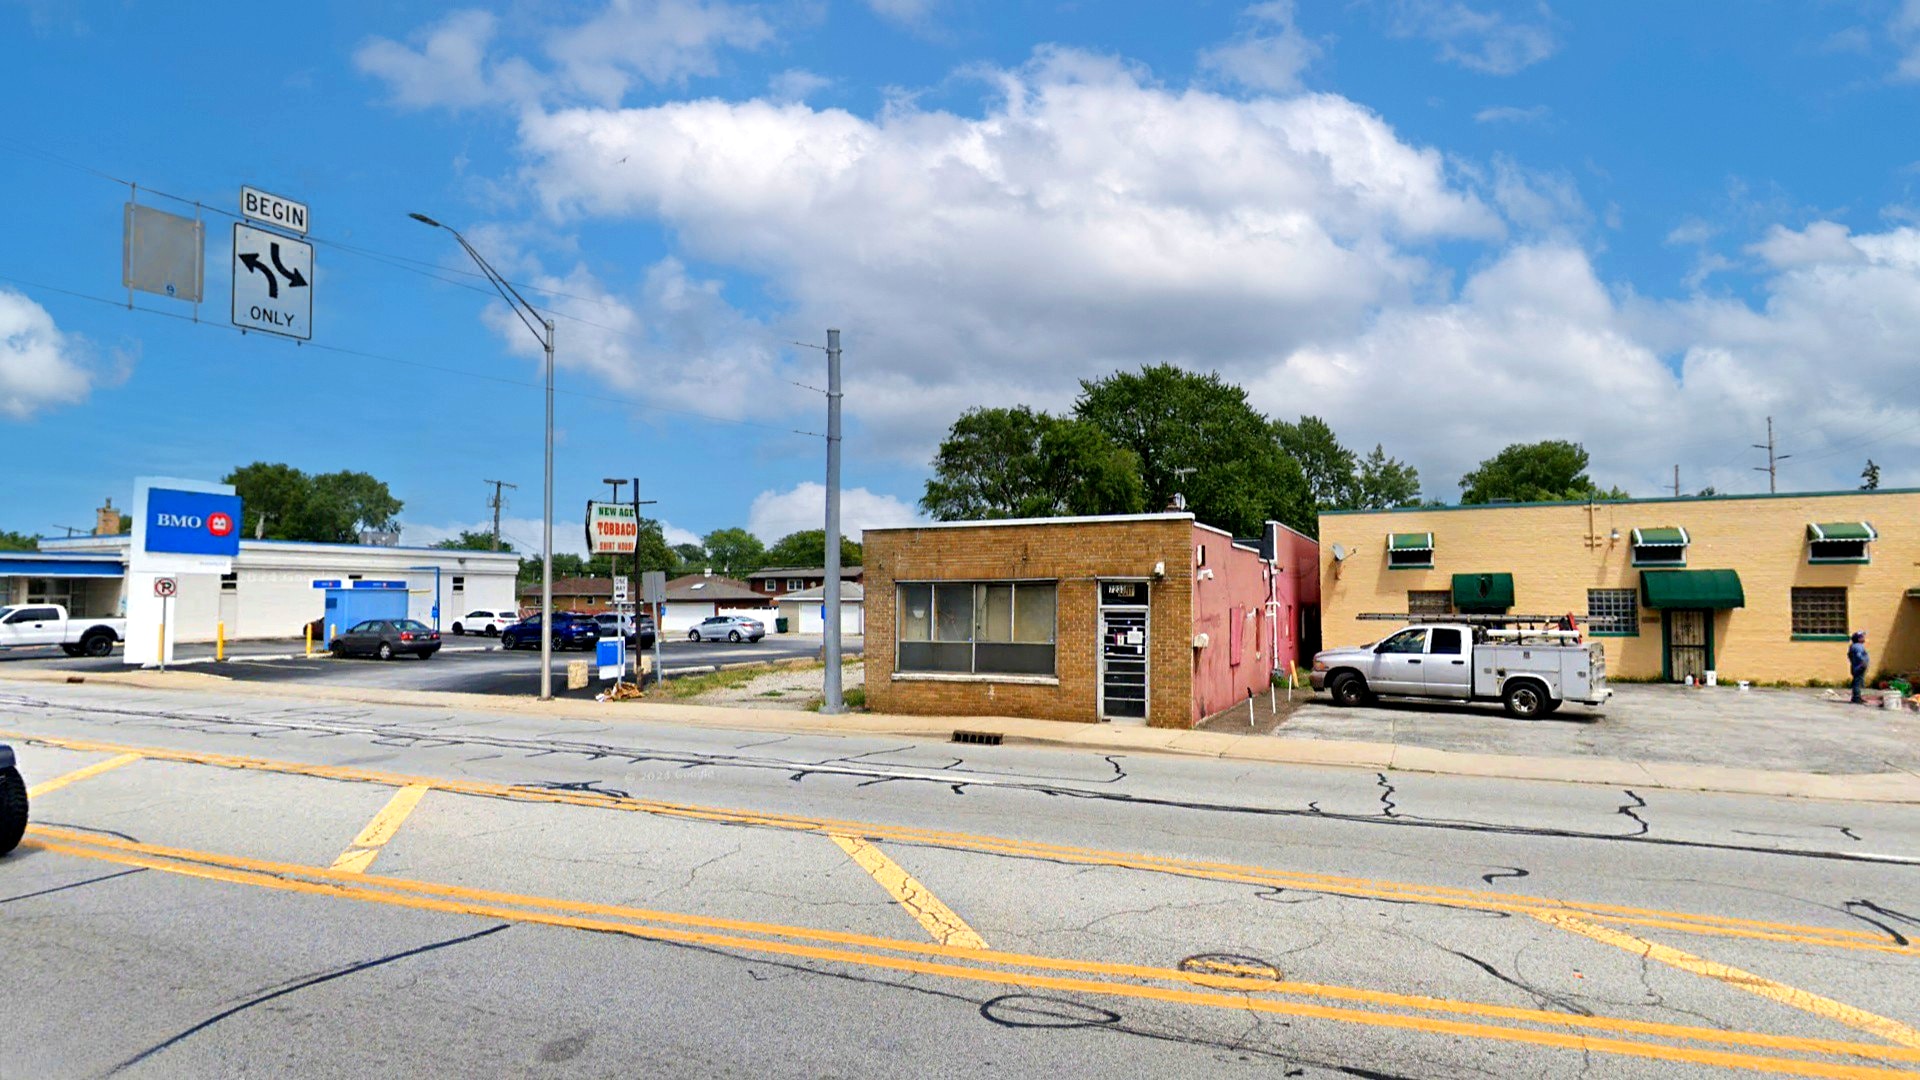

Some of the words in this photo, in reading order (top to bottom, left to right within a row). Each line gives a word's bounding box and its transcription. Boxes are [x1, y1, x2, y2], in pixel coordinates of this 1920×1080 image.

[246, 193, 304, 227] BEGIN
[250, 306, 295, 327] ONLY
[598, 507, 616, 516] NEW
[619, 509, 634, 518] AGE
[157, 513, 202, 528] BMO
[597, 522, 637, 536] TOBBACO
